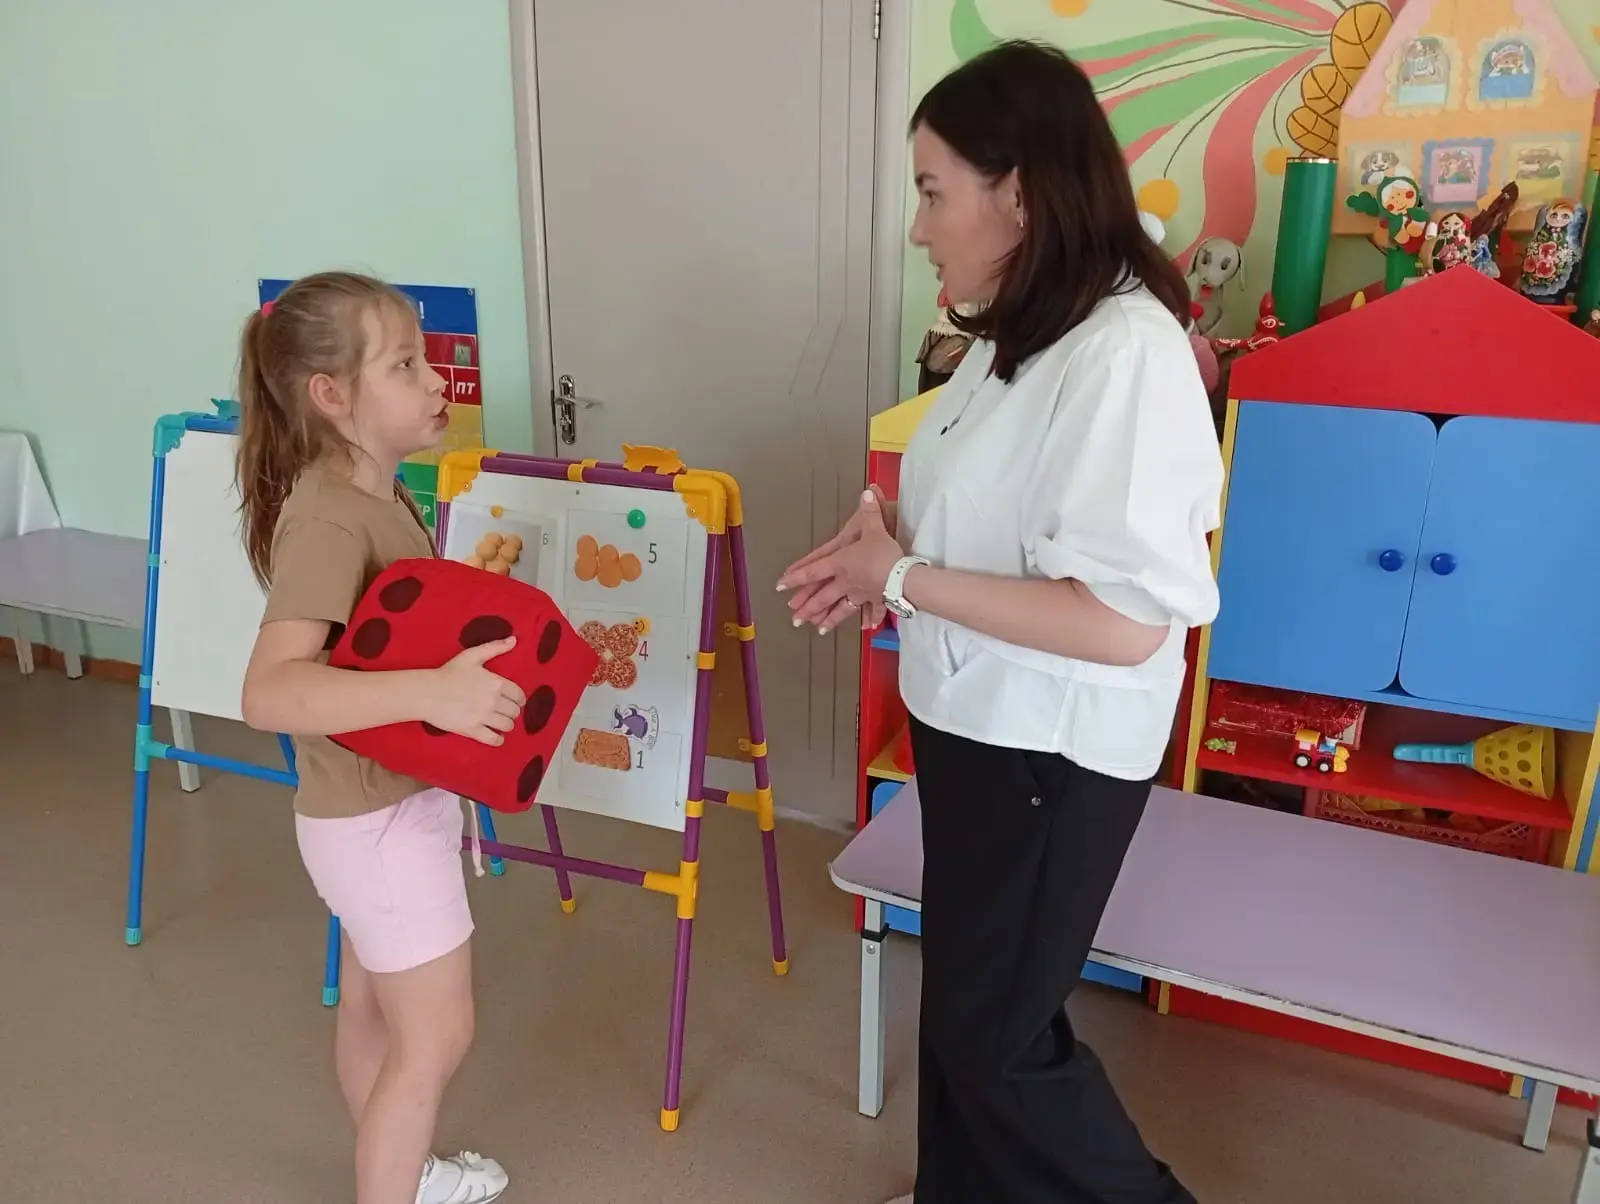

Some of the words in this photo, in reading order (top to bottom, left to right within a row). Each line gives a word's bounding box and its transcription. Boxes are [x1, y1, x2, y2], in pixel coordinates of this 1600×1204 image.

[456, 382, 476, 395] ПТ
[542, 533, 549, 546] 6
[648, 542, 657, 564] 5
[638, 640, 649, 661] 4
[635, 750, 645, 769] 1
